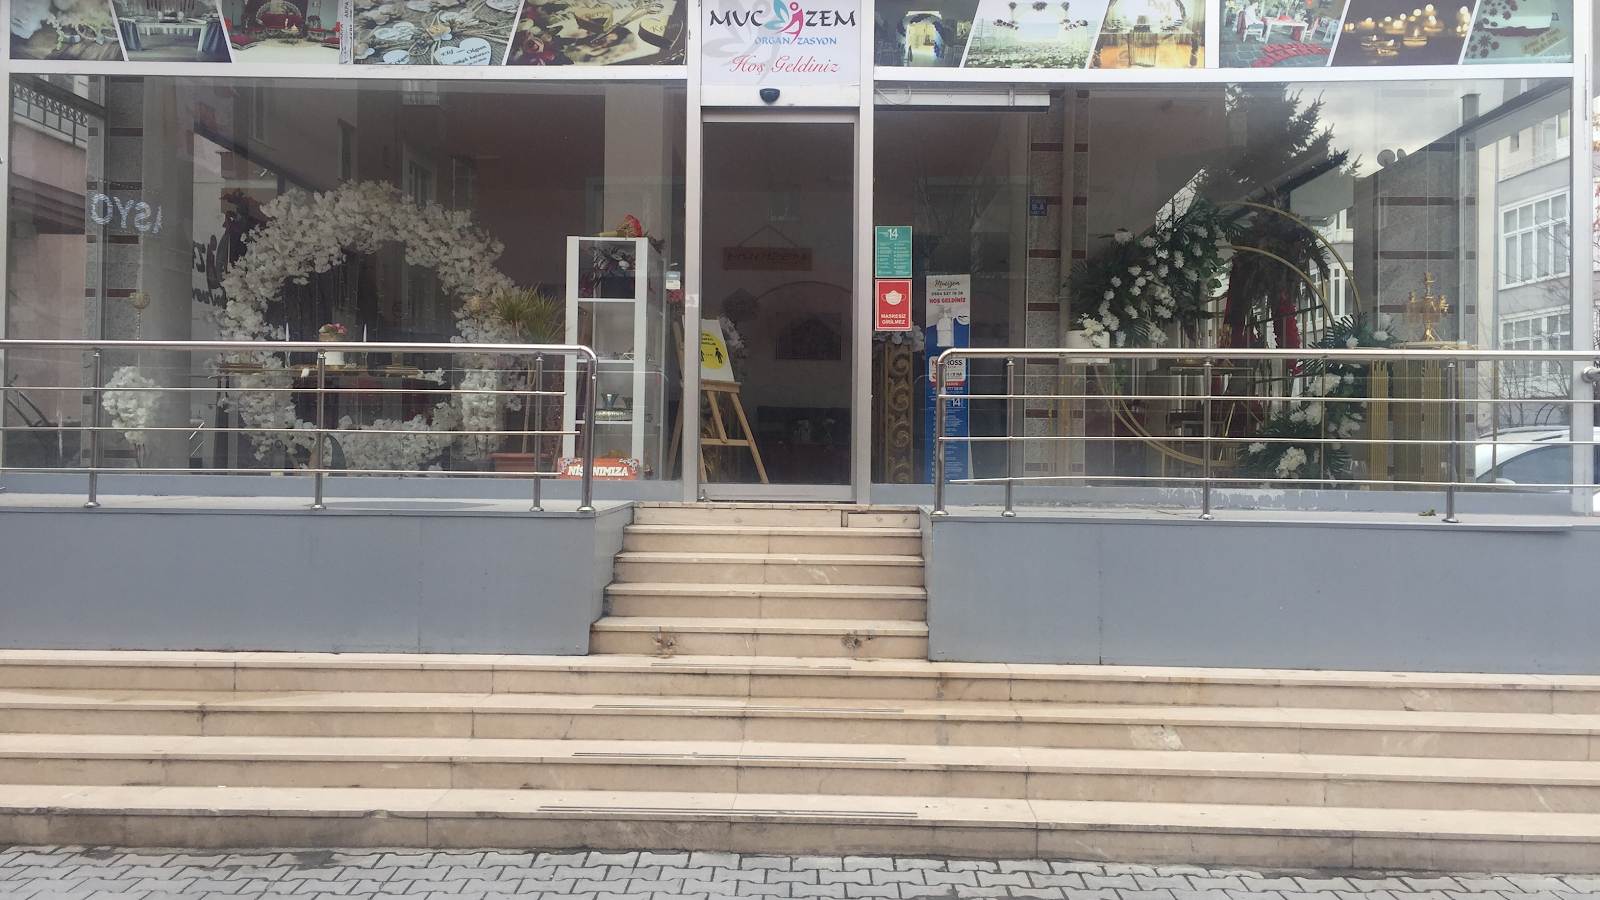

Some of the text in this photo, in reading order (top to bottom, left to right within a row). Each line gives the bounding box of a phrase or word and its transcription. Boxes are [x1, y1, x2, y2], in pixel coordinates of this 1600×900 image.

[440, 45, 487, 57] Elif Olgun
[730, 55, 841, 75] Hoş Geldiniz
[887, 228, 898, 238] 14
[934, 279, 961, 289] Mucizem
[951, 398, 961, 407] 14
[567, 464, 629, 477] NİŞNIMIZA
